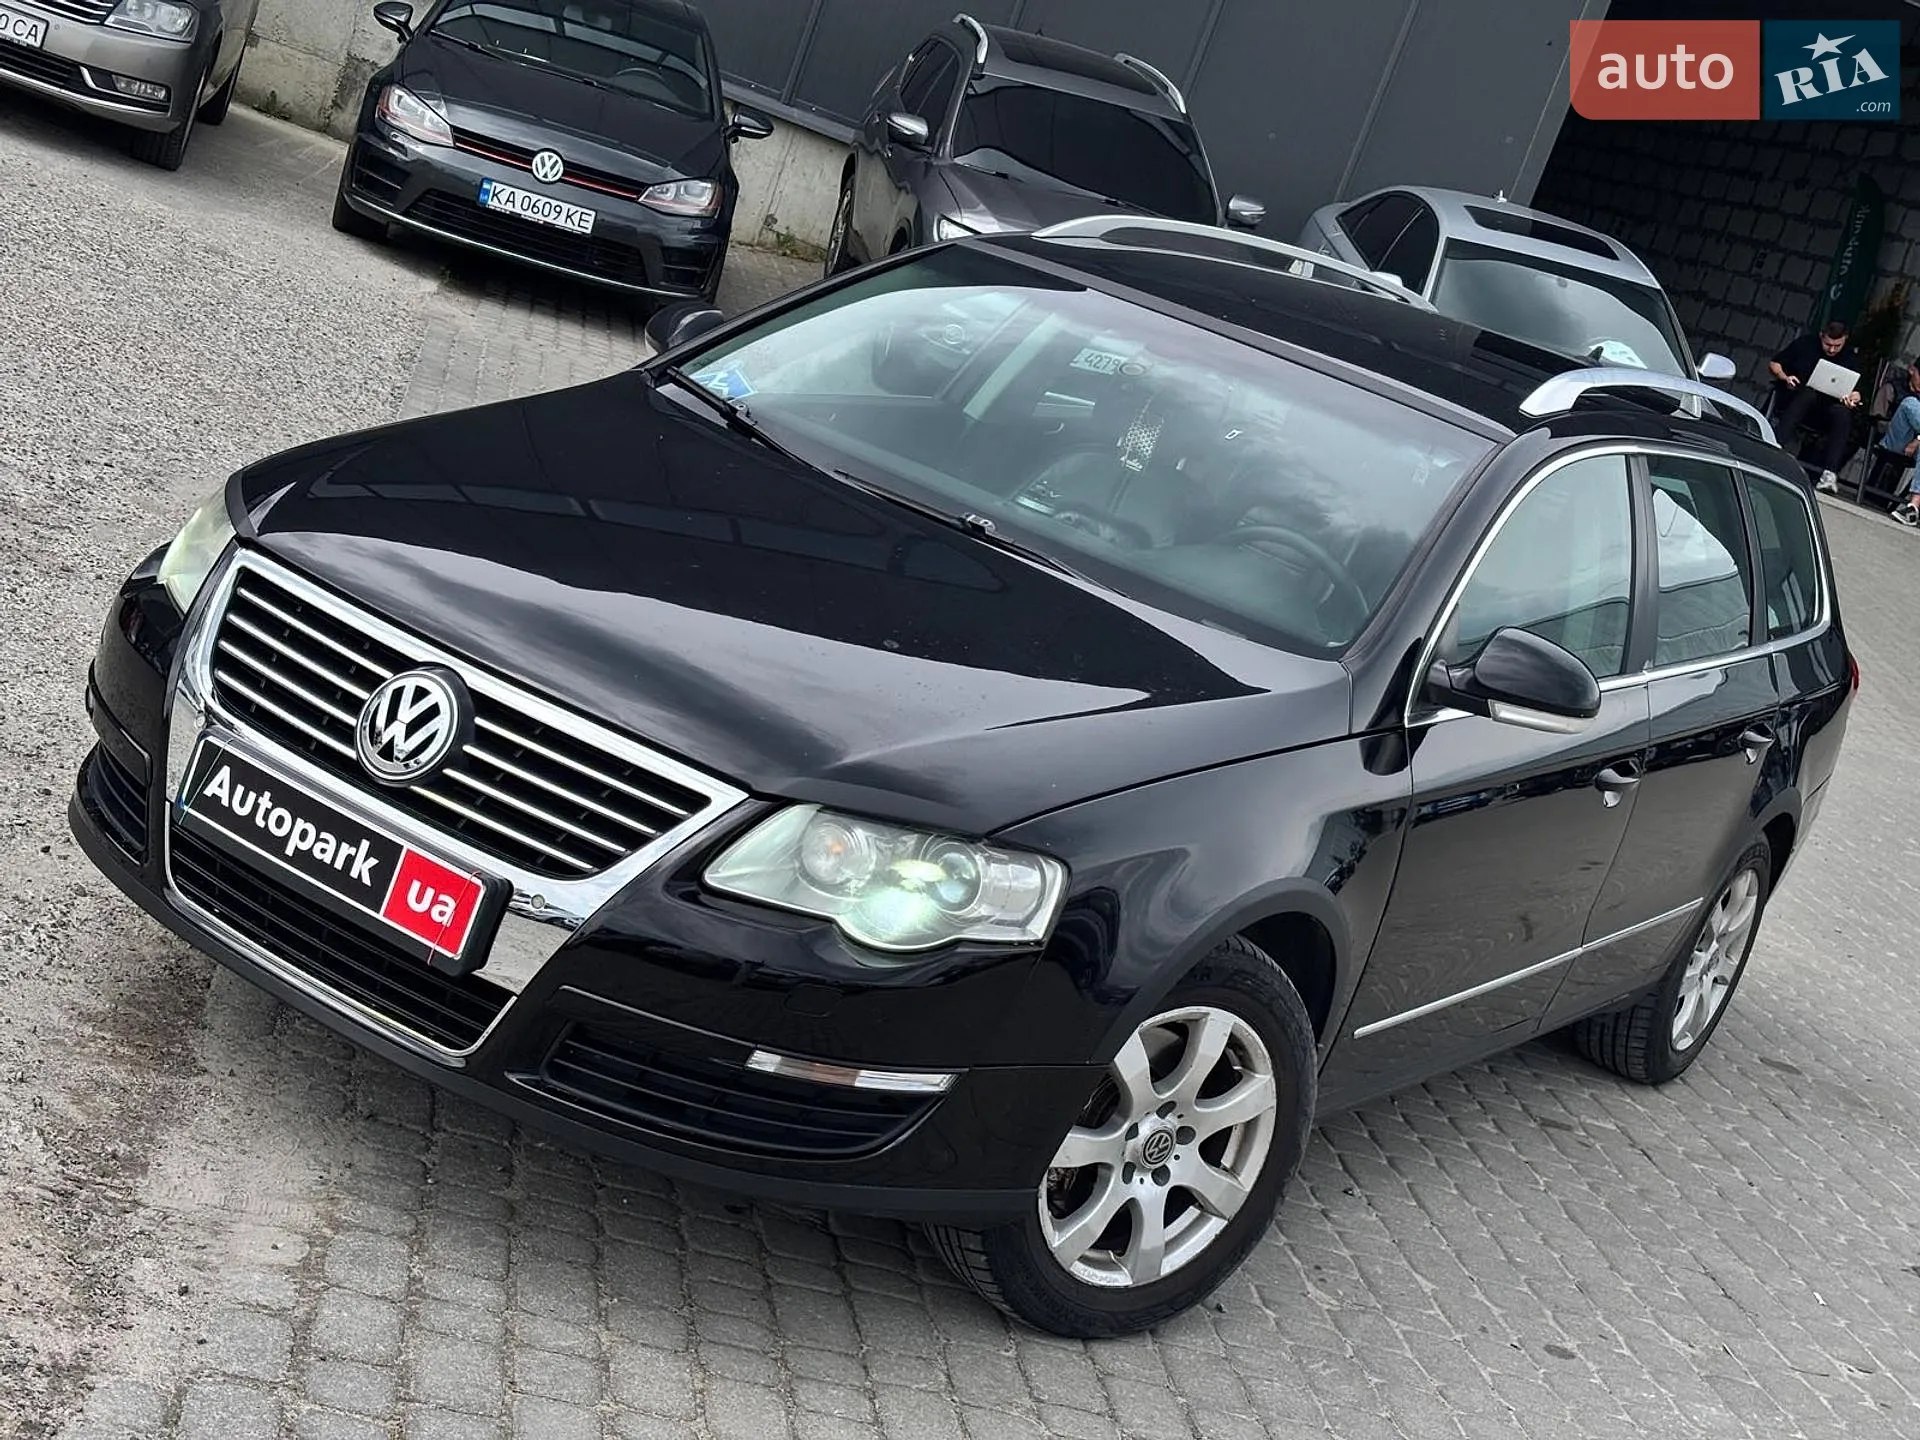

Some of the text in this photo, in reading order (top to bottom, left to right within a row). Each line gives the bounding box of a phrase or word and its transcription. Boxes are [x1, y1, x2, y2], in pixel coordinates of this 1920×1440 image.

[13, 19, 38, 42] CA
[490, 185, 516, 208] KA
[520, 195, 563, 221] 0609
[565, 207, 592, 231] KE
[203, 765, 457, 927] Autopark ua
